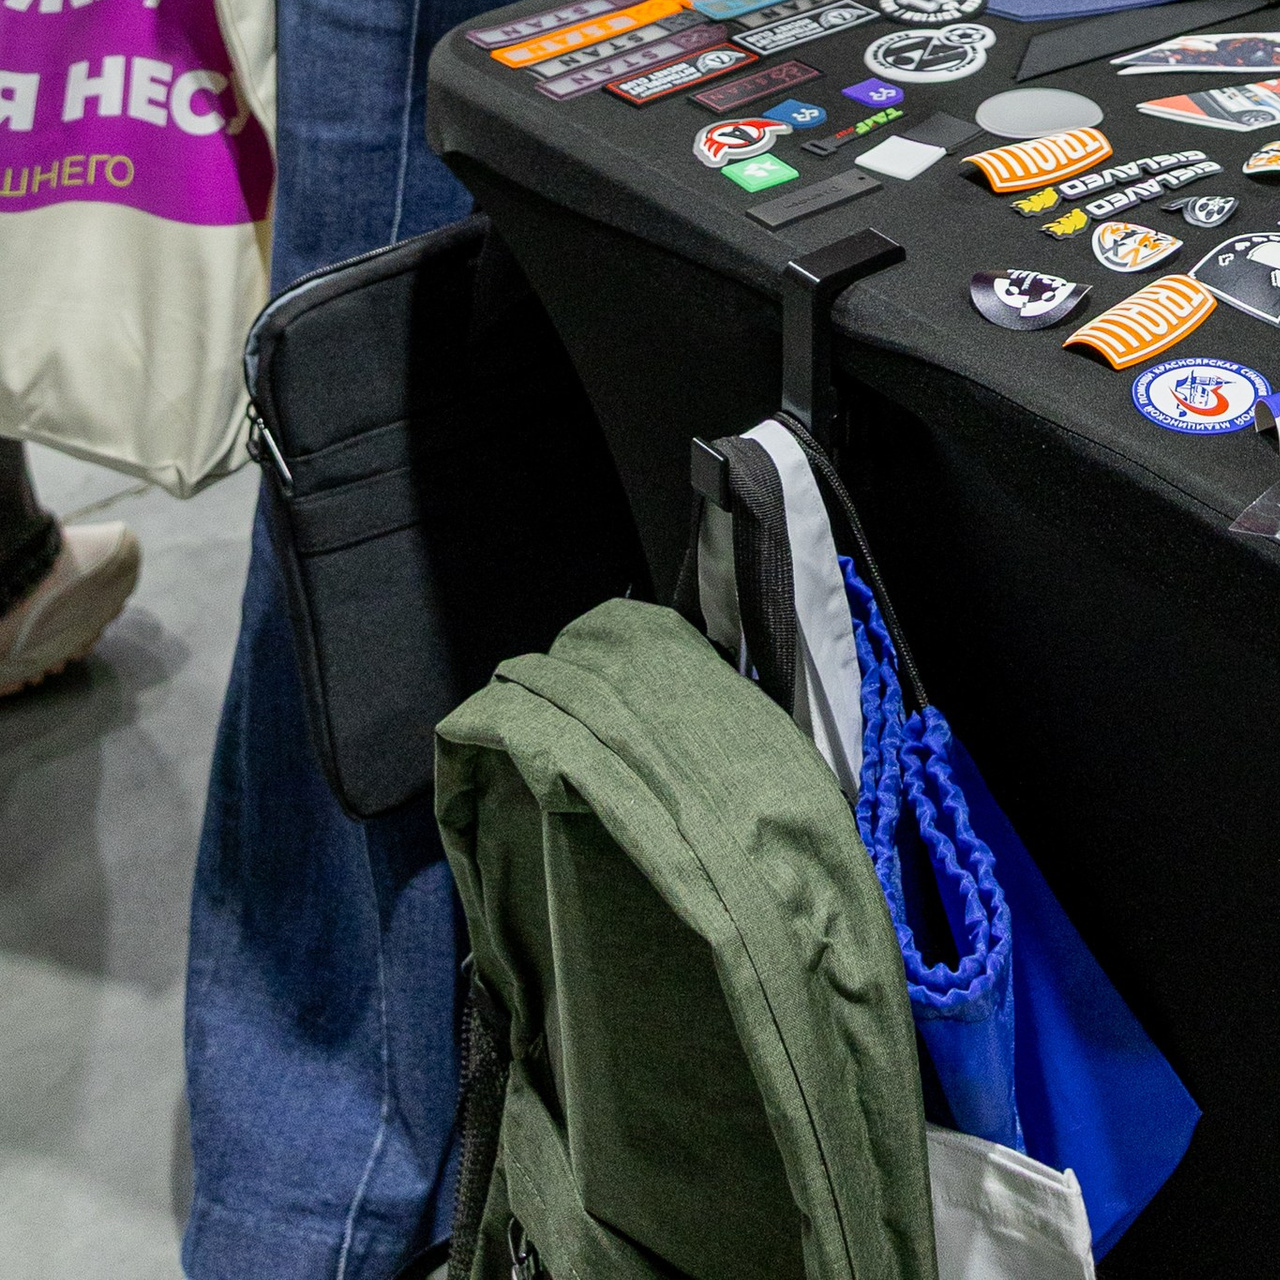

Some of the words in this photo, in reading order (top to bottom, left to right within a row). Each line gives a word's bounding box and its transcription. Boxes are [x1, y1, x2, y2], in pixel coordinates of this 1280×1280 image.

[1060, 151, 1207, 196] GISLAVED
[1086, 162, 1222, 217] GISLAVED
[1152, 358, 1239, 375] КРАСНОЯРСКАЯ
[1137, 372, 1155, 404] ПОМОЩИ
[1143, 405, 1231, 430] МЕДИЦИНСКОЙ
